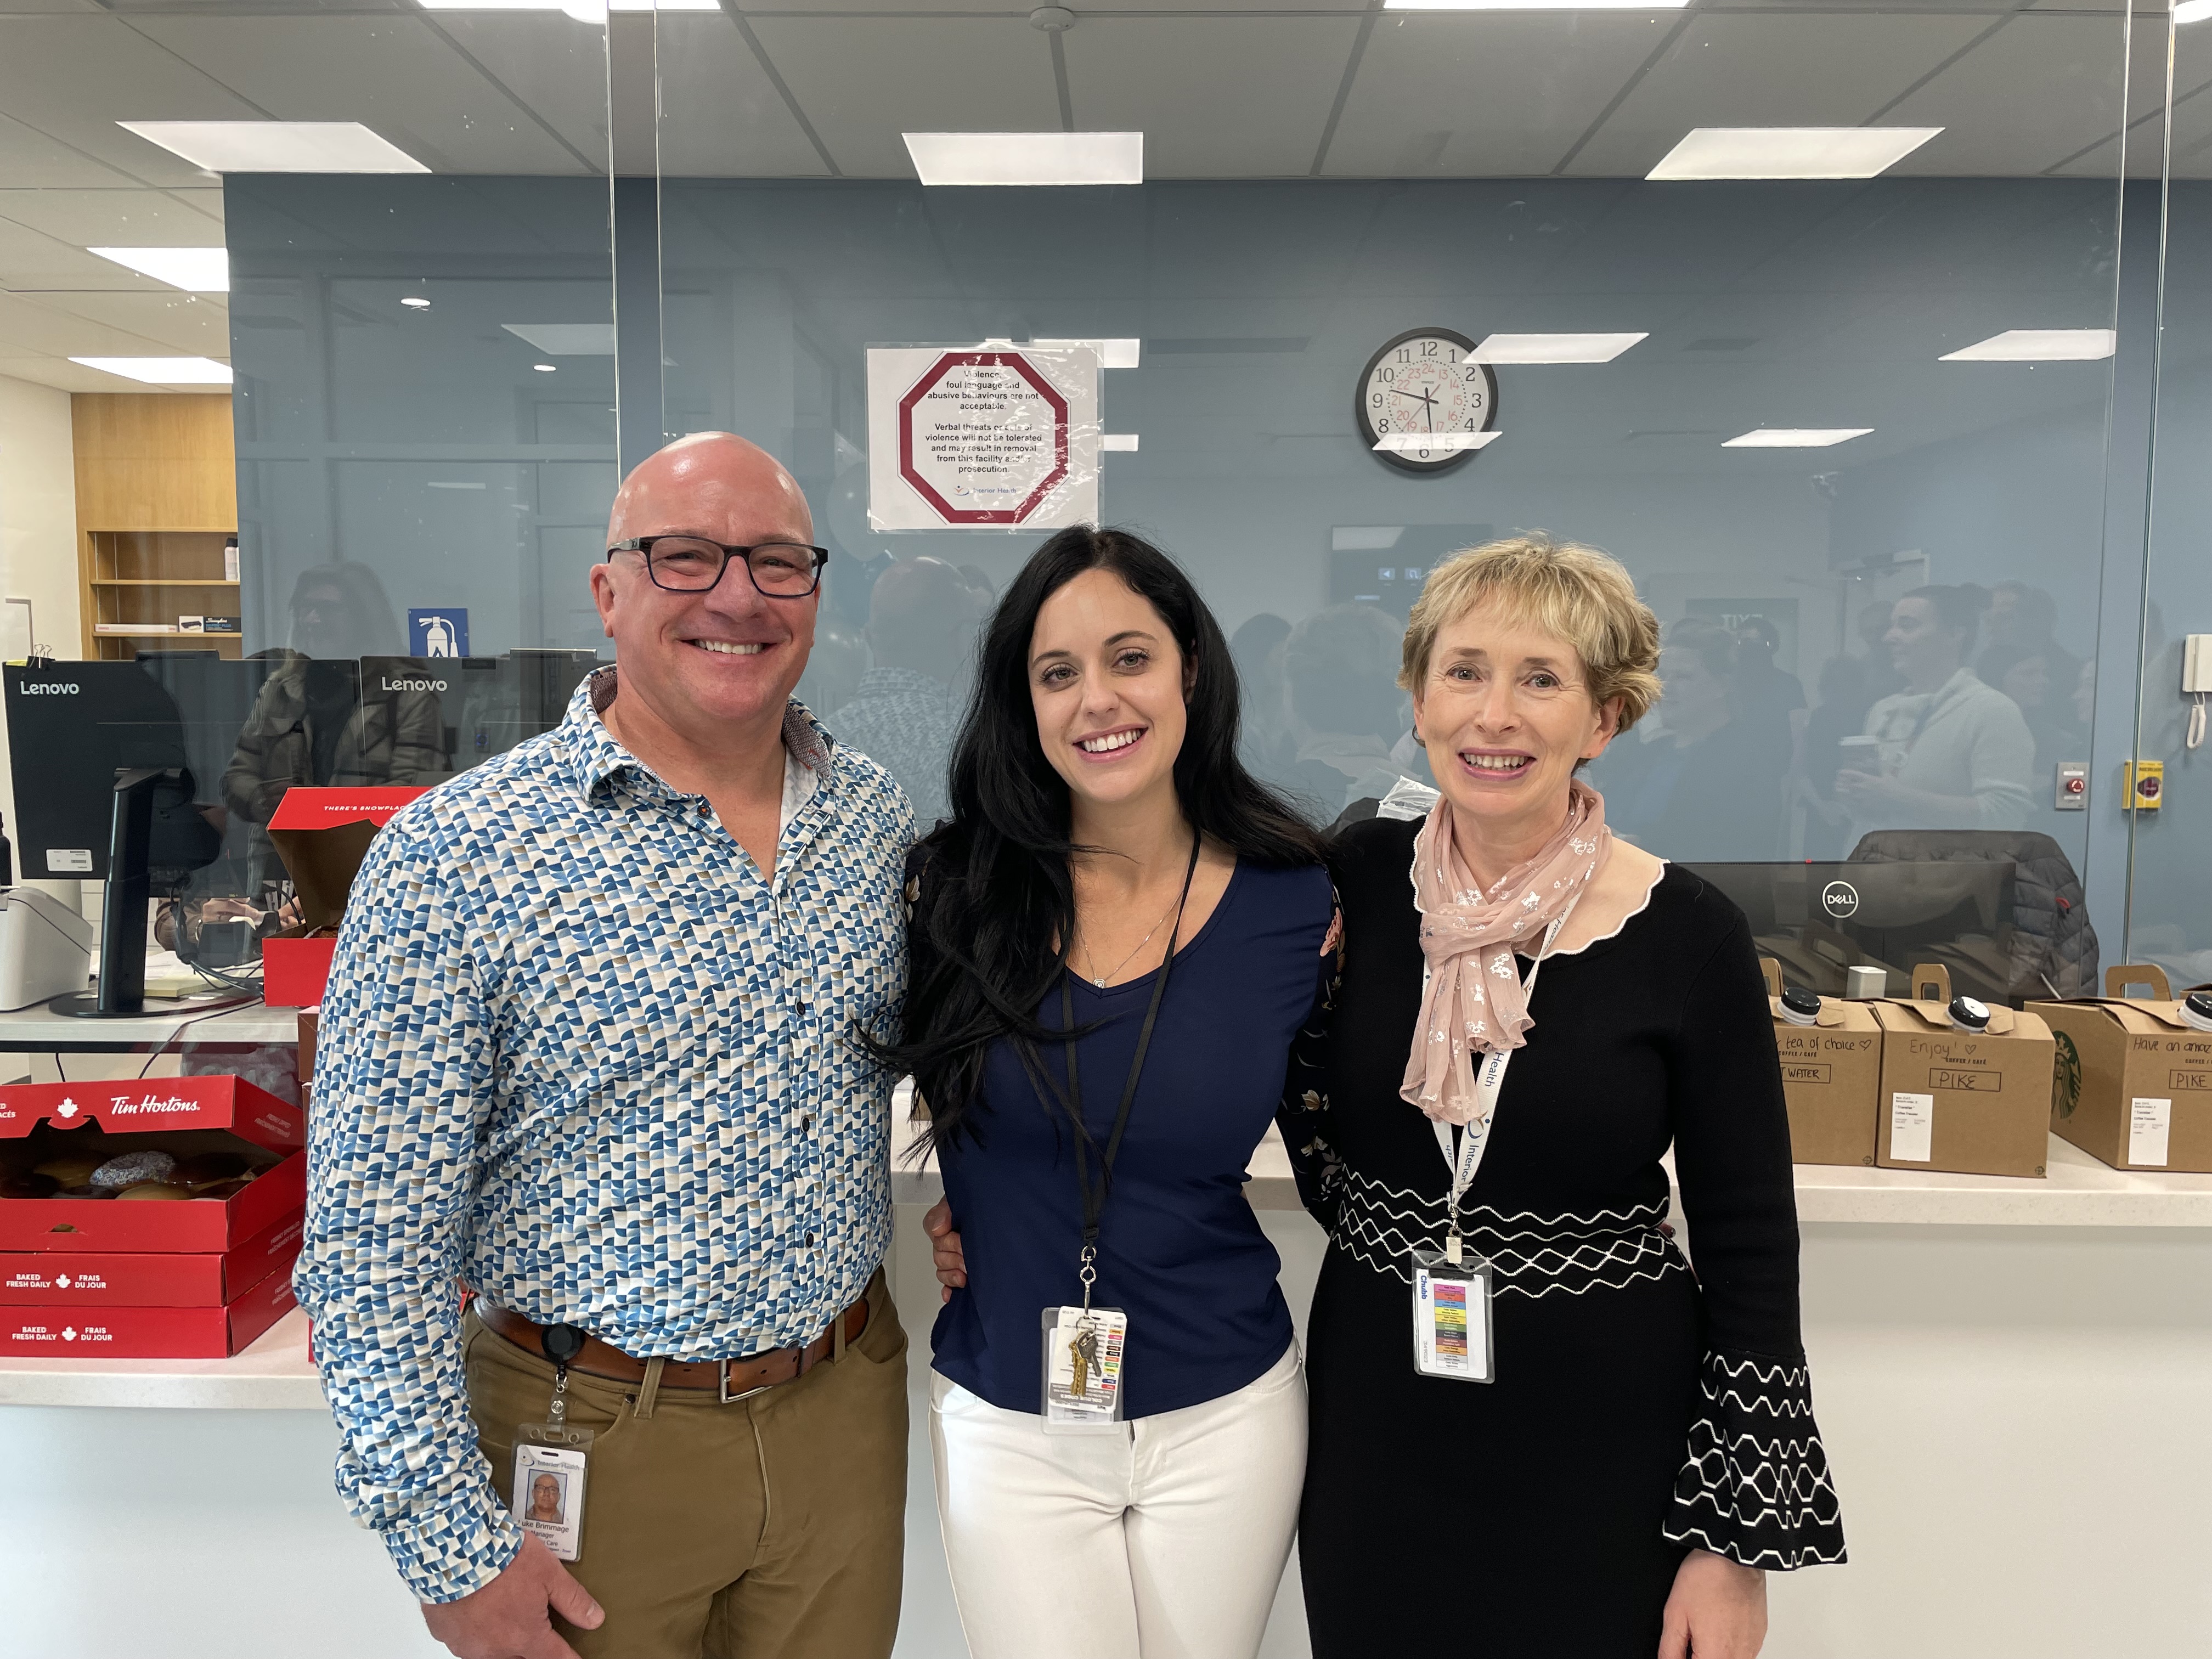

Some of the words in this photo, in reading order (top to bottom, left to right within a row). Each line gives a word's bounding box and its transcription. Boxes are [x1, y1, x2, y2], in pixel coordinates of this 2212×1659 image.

[1420, 341, 1437, 356] 12
[1396, 349, 1411, 363] 11
[1449, 349, 1457, 363] 1
[1376, 368, 1394, 382] 10
[1408, 369, 1421, 379] 23
[1422, 364, 1435, 374] 24
[1438, 369, 1448, 380] 13
[1465, 367, 1475, 381] 2
[1397, 380, 1410, 390] 22
[1450, 379, 1459, 390] 14
[1373, 393, 1383, 408] 9
[1391, 396, 1401, 406] 21
[1453, 395, 1463, 405] 15
[1471, 393, 1481, 408] 3
[1396, 410, 1409, 421] 20
[1448, 411, 1458, 421] 16
[1379, 419, 1389, 433] 8
[1407, 421, 1417, 432] 19
[1436, 421, 1444, 431] 17
[1464, 418, 1475, 432] 4
[1419, 443, 1429, 459] 6
[1444, 437, 1454, 452] 5
[976, 455, 1003, 463] facility
[20, 681, 79, 695] Lenovo
[382, 676, 448, 691] Lenovo
[1827, 894, 1855, 905] DELL
[1786, 1036, 1803, 1049] tea
[1809, 1037, 1819, 1051] of
[1824, 1037, 1855, 1051] choice
[2133, 1037, 2159, 1051] Have
[2166, 1042, 2180, 1051] an
[1485, 1052, 1504, 1086] Health
[1788, 1068, 1820, 1080] WATER
[1939, 1071, 1977, 1090] PIKE
[2176, 1073, 2207, 1088] PIKE
[111, 1096, 138, 1115] Tim
[140, 1094, 198, 1114] Hortons
[1462, 1145, 1479, 1182] Interior
[536, 1522, 569, 1533] Brimmage
